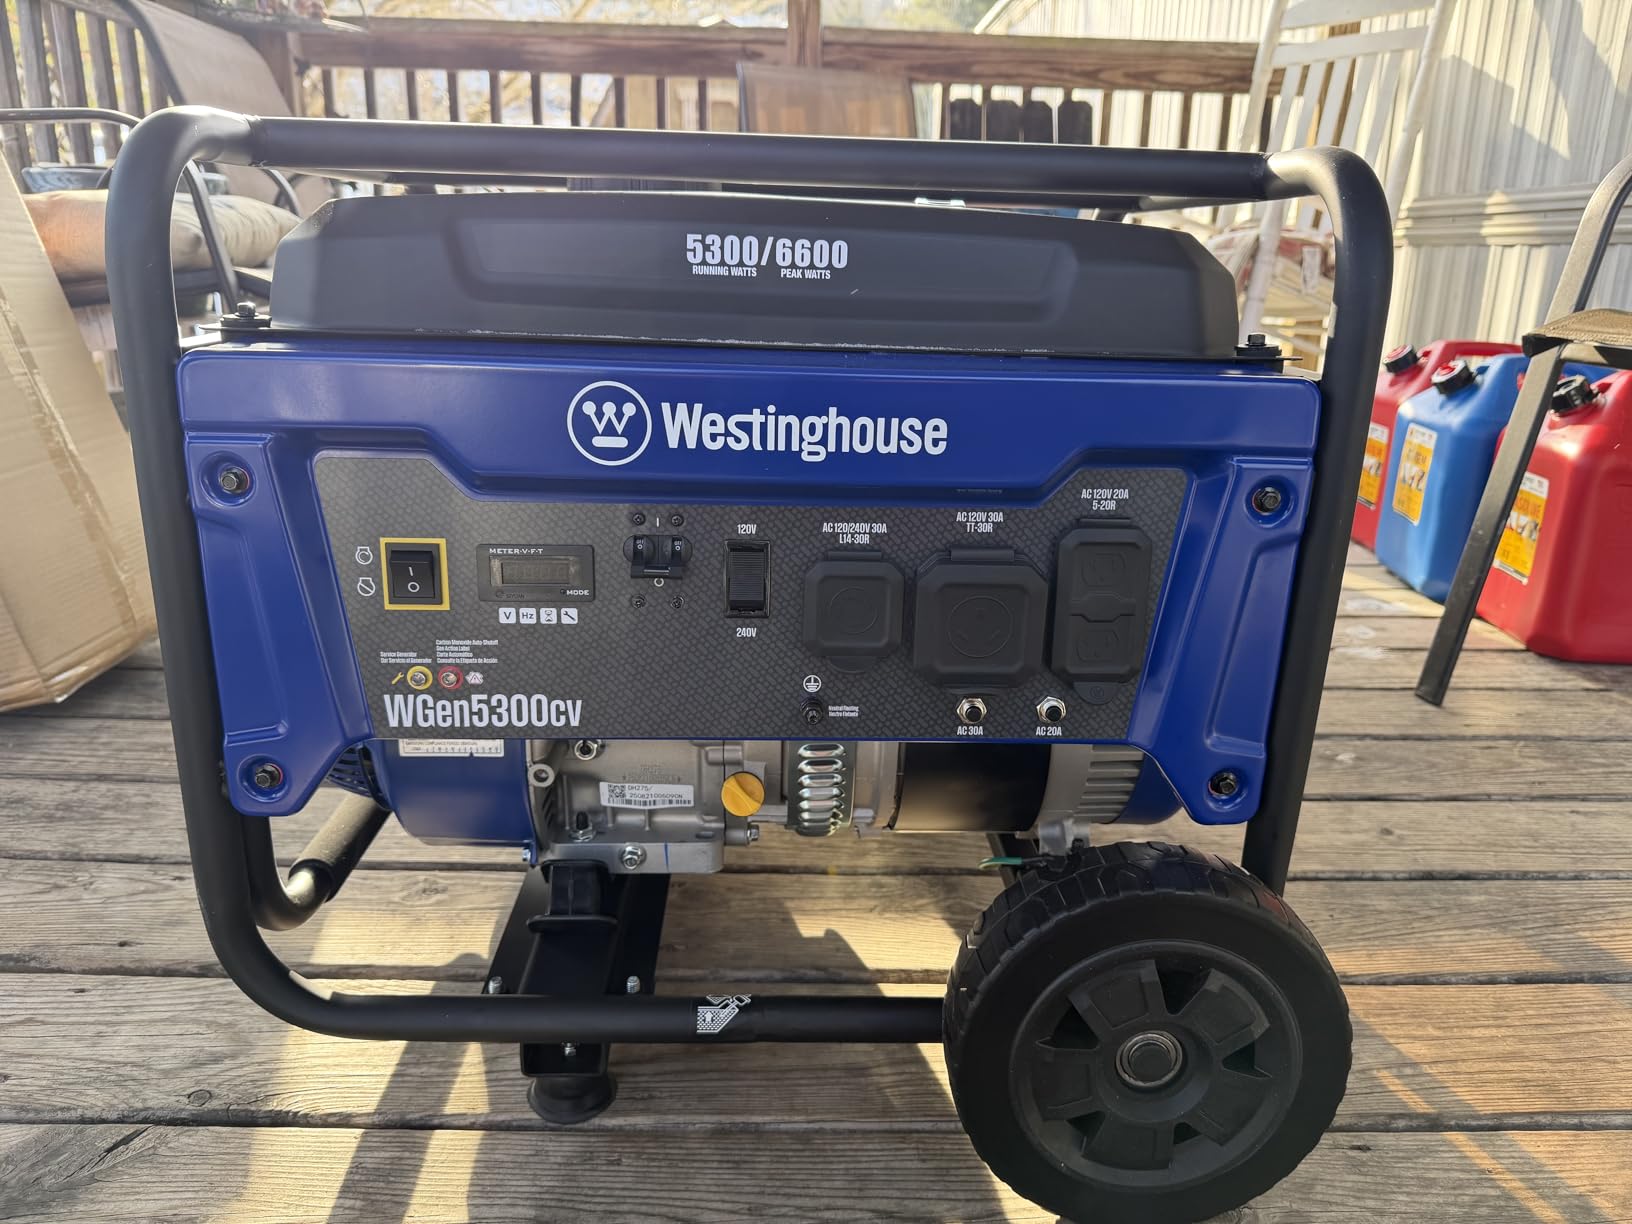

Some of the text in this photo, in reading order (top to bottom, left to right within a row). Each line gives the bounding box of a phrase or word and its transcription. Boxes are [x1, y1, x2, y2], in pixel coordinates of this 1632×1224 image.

[686, 233, 849, 268] 5300/6600
[692, 265, 757, 277] RUNNING WATTS
[780, 268, 831, 279] PEAK WATTS
[661, 402, 948, 463] Westinghouse
[1081, 488, 1129, 499] AC 120V 20A
[1092, 500, 1116, 511] 5-20R
[956, 511, 1004, 523] AC 120V 30A
[737, 524, 757, 534] 120V
[822, 522, 888, 534] AC 120/240V 30A
[966, 522, 993, 533] TT-30R
[839, 534, 870, 544] L14-30R
[503, 611, 534, 620] V Hz
[736, 627, 757, 638] 240V
[383, 694, 582, 728] WGen5300cv
[956, 726, 984, 735] AC 30A
[1036, 726, 1062, 736] AC 20A
